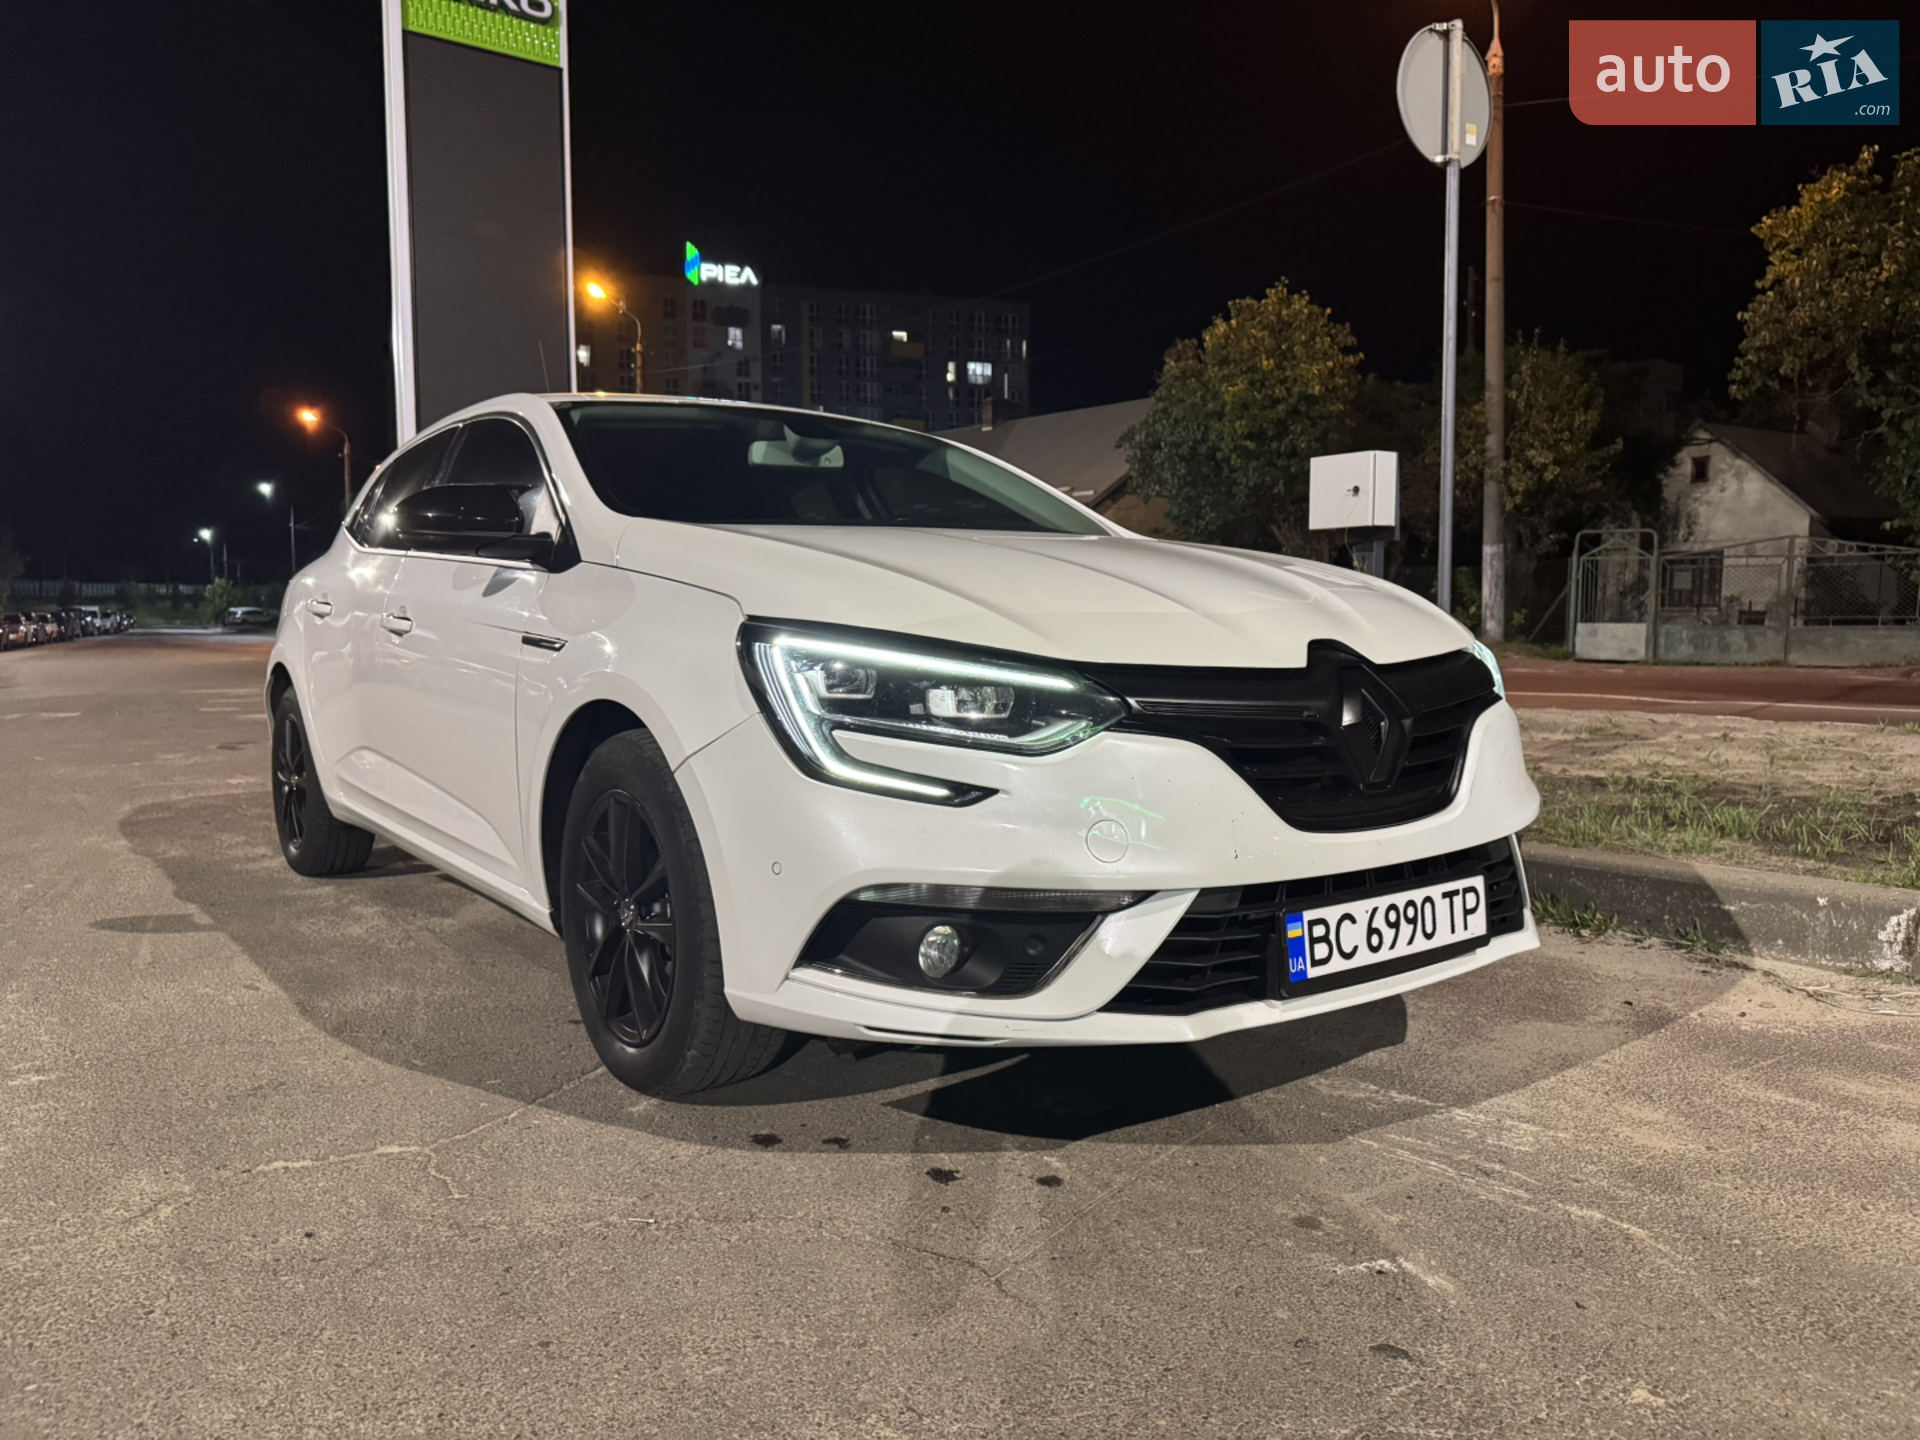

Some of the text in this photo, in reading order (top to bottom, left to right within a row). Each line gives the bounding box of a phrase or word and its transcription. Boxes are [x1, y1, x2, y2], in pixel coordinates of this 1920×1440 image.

[1307, 885, 1480, 969] BC 6990 TP
[1289, 956, 1306, 973] UA
